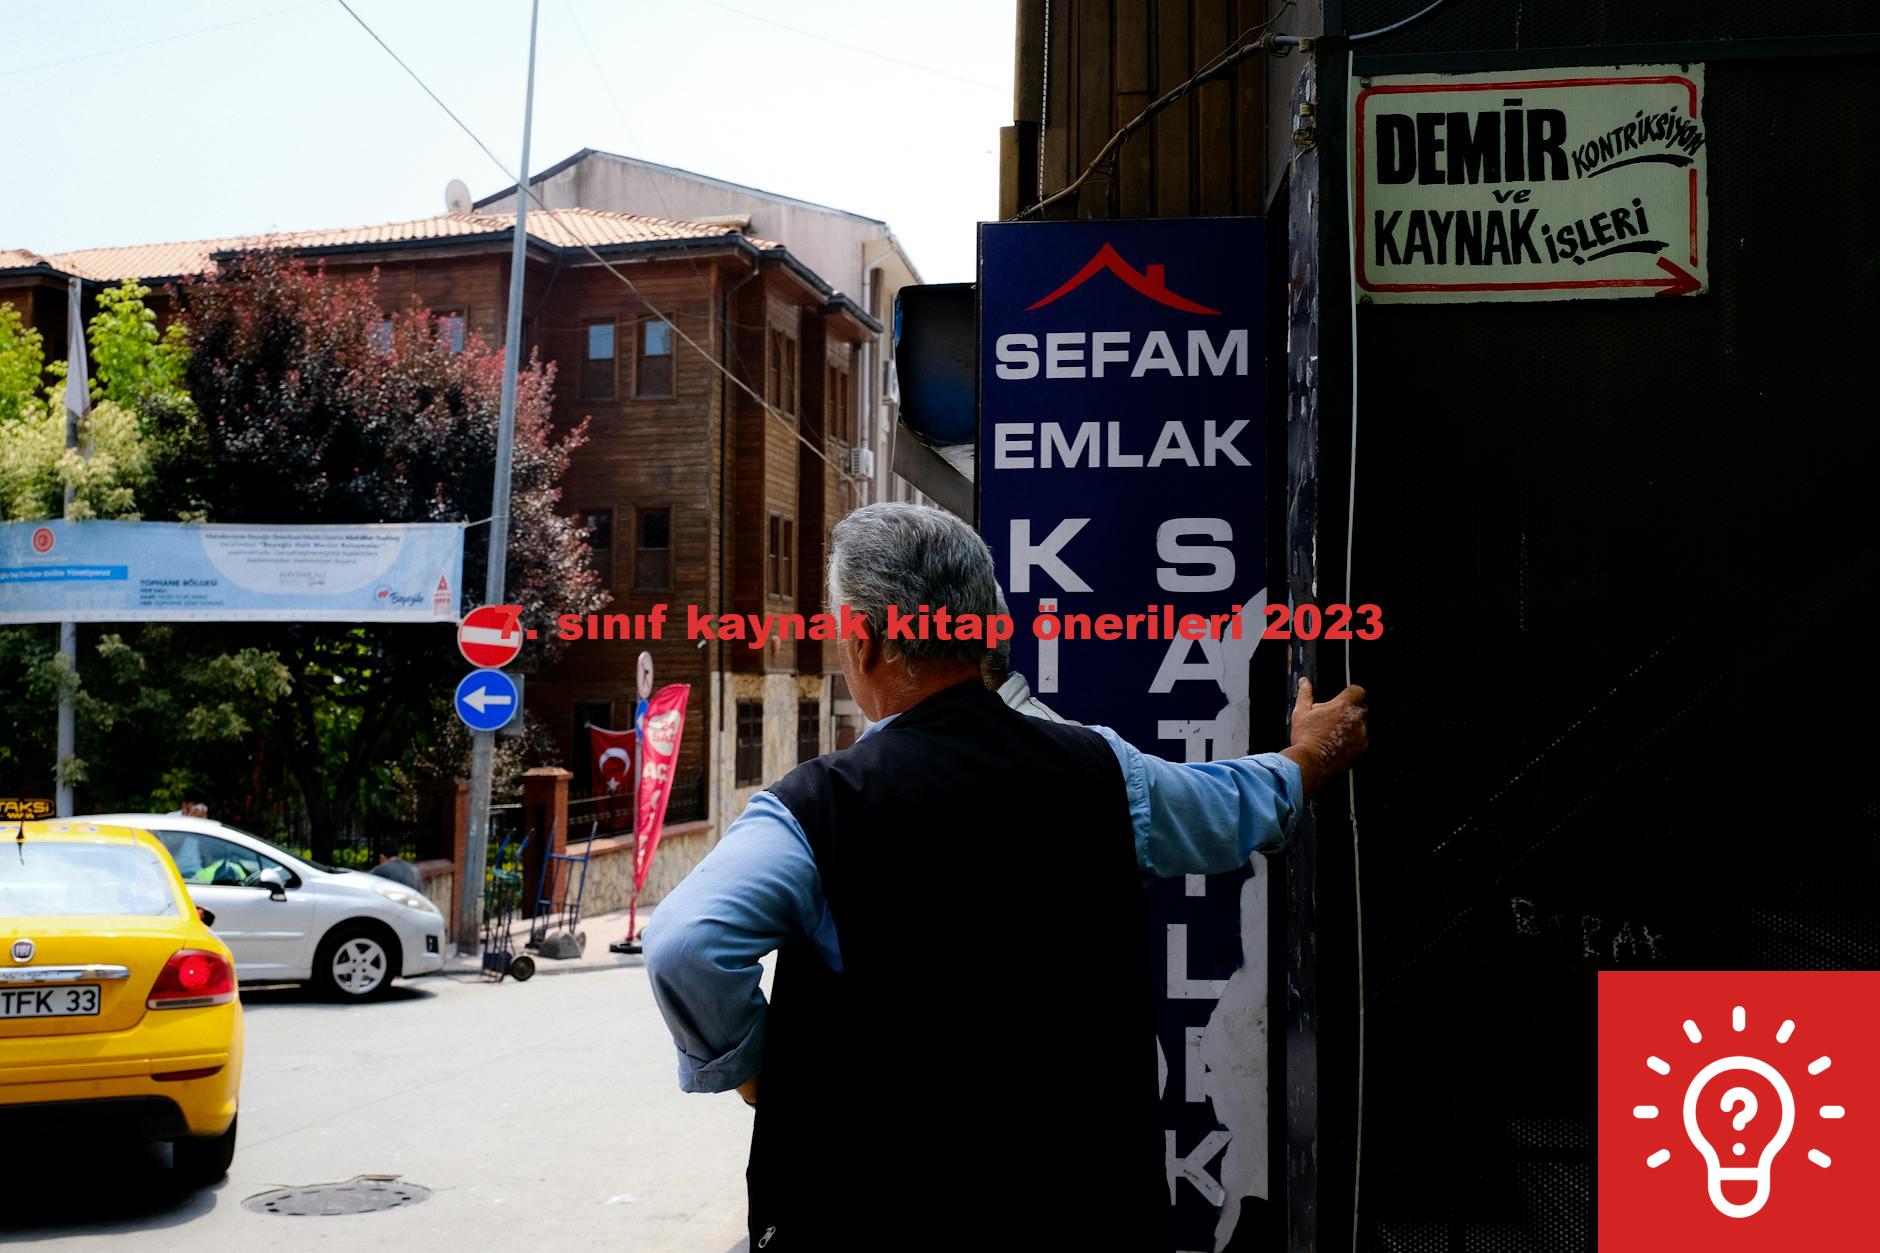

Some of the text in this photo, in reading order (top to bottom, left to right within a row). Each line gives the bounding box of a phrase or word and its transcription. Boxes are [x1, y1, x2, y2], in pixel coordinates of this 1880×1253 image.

[1375, 98, 1570, 186] DEMİR
[1491, 189, 1532, 204] ve
[1374, 208, 1543, 267] KAYNAK
[995, 329, 1249, 381] SEFAM
[994, 419, 1252, 470] EMLAK
[140, 579, 179, 587] TOPHANE
[1, 989, 97, 1014] TFK 33
